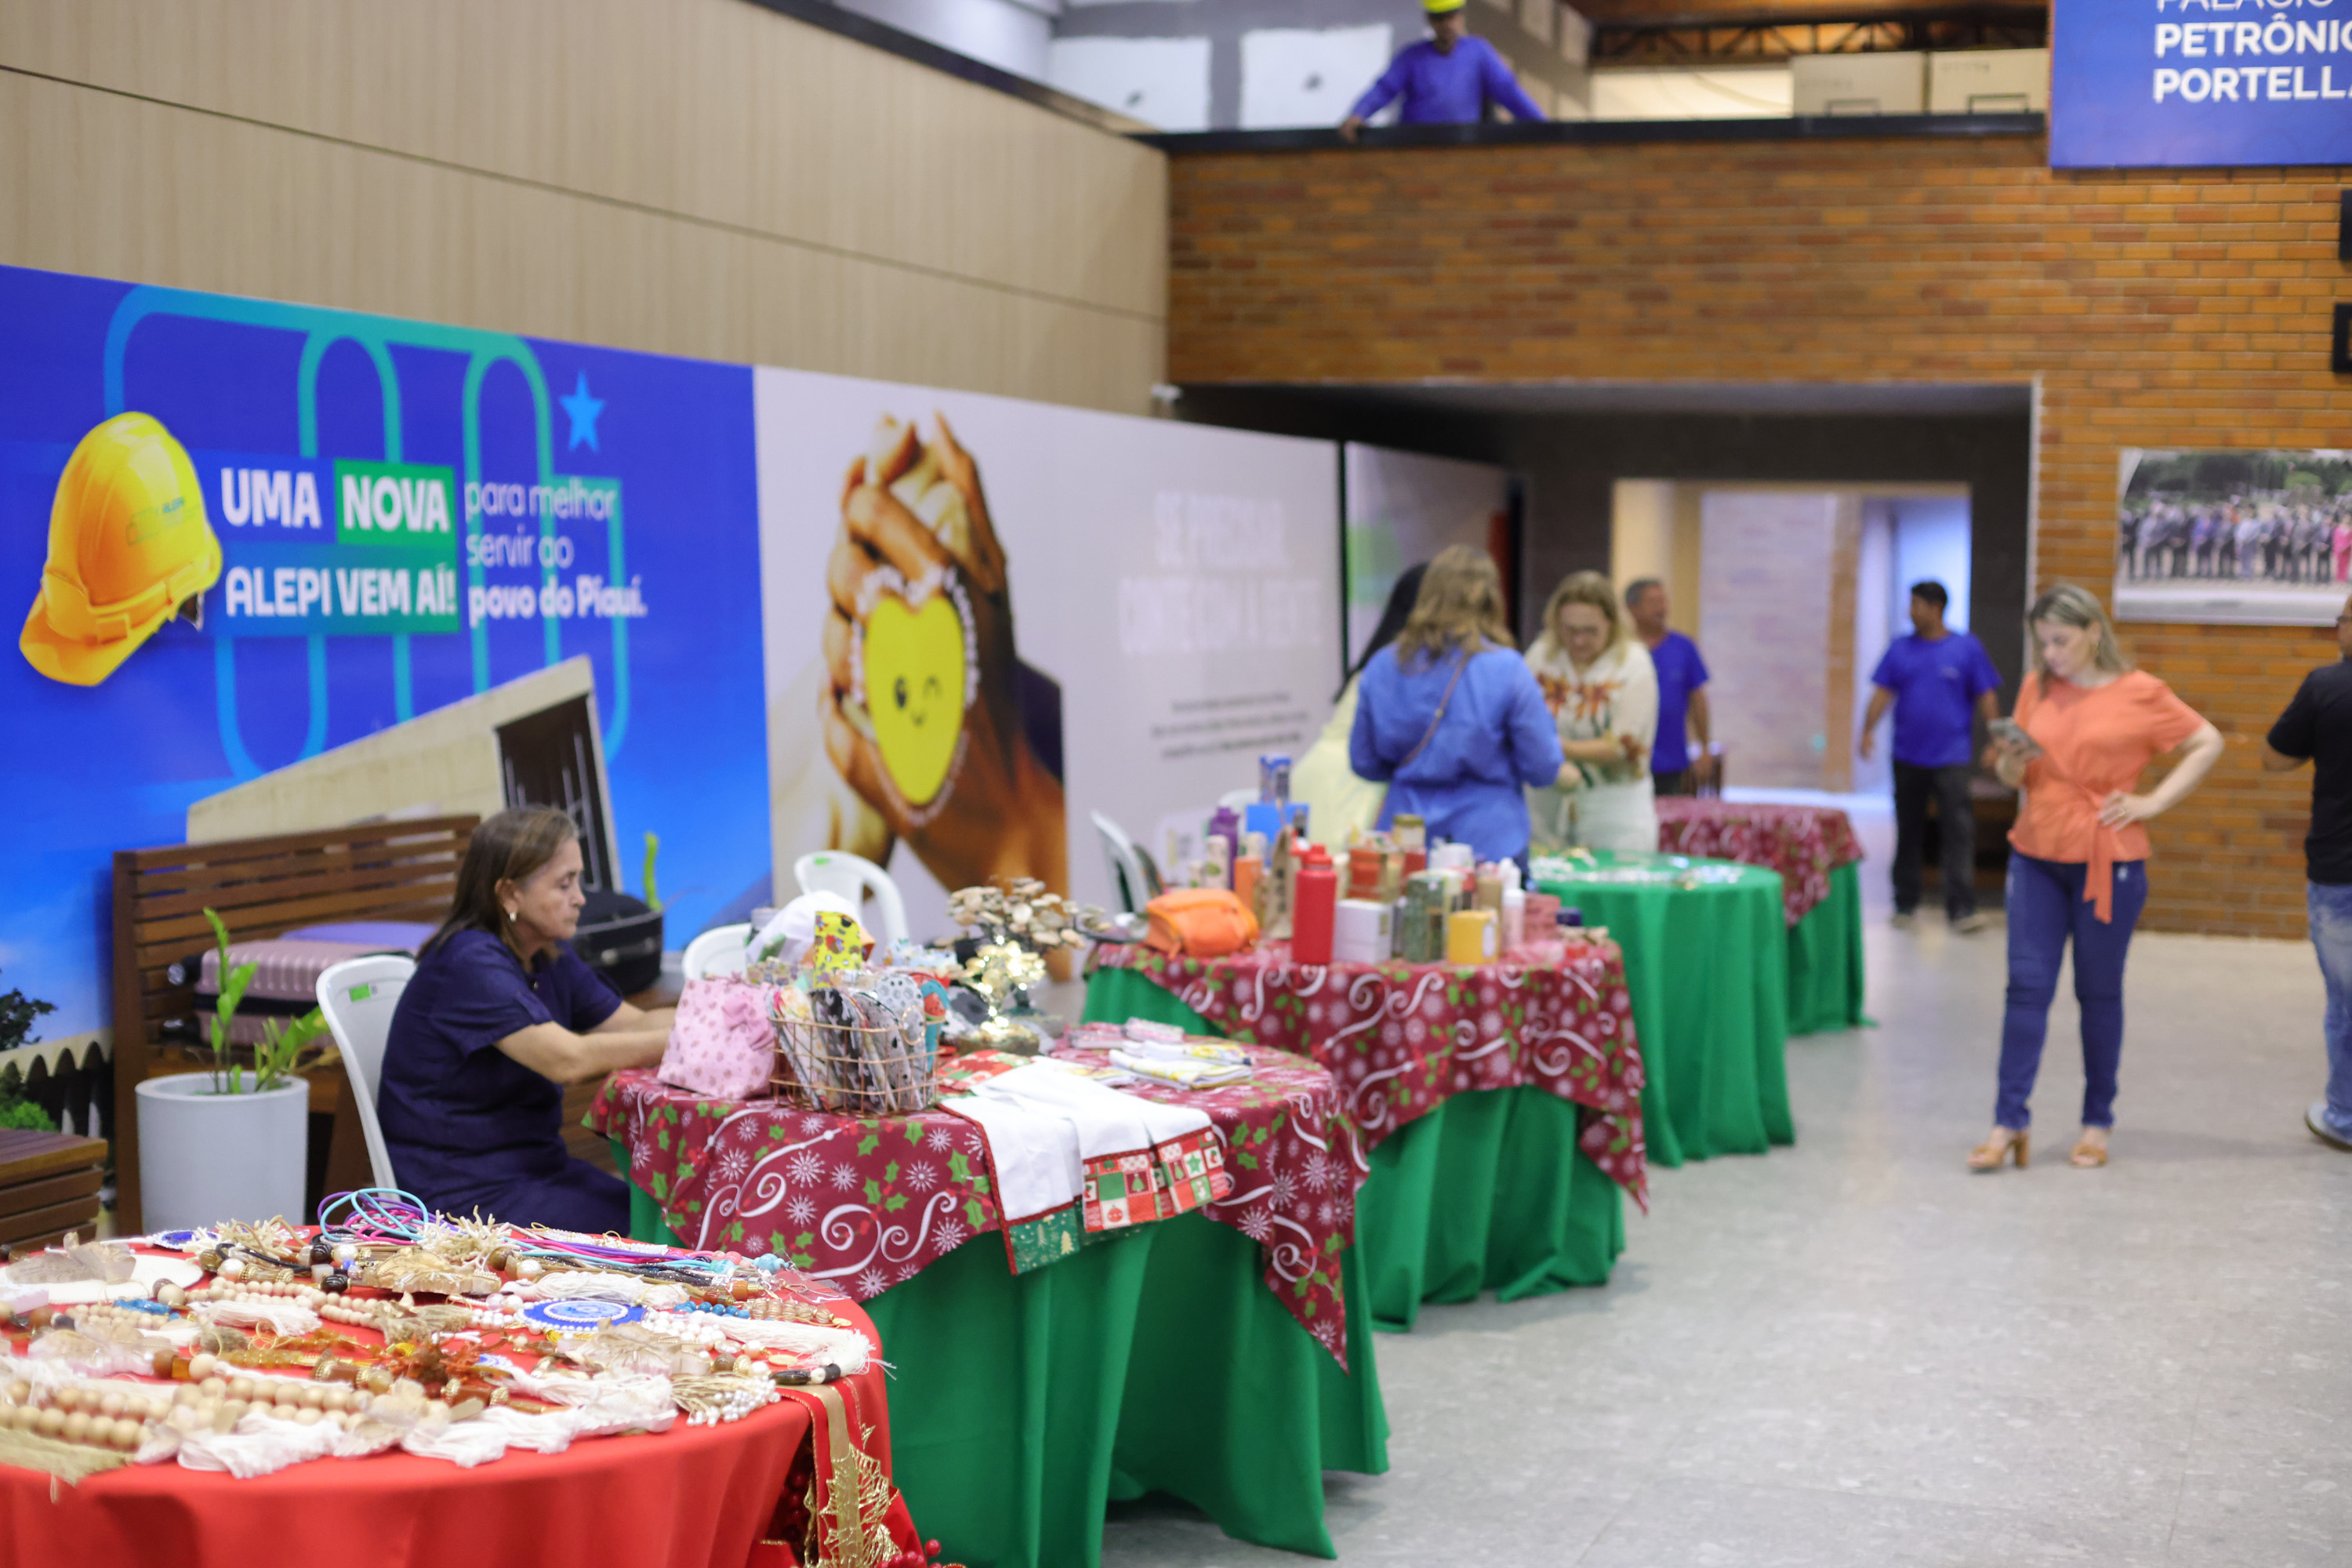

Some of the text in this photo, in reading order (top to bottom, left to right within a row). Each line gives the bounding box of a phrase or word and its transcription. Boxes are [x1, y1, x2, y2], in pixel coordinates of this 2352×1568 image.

[2153, 66, 2352, 103] PORTELL
[221, 467, 451, 533] UMA NOVA
[464, 476, 617, 524] para melhor
[466, 523, 575, 568] servir ao
[226, 562, 457, 617] ALEPI VEM AÍ!
[468, 574, 648, 629] povo do Piauí.
